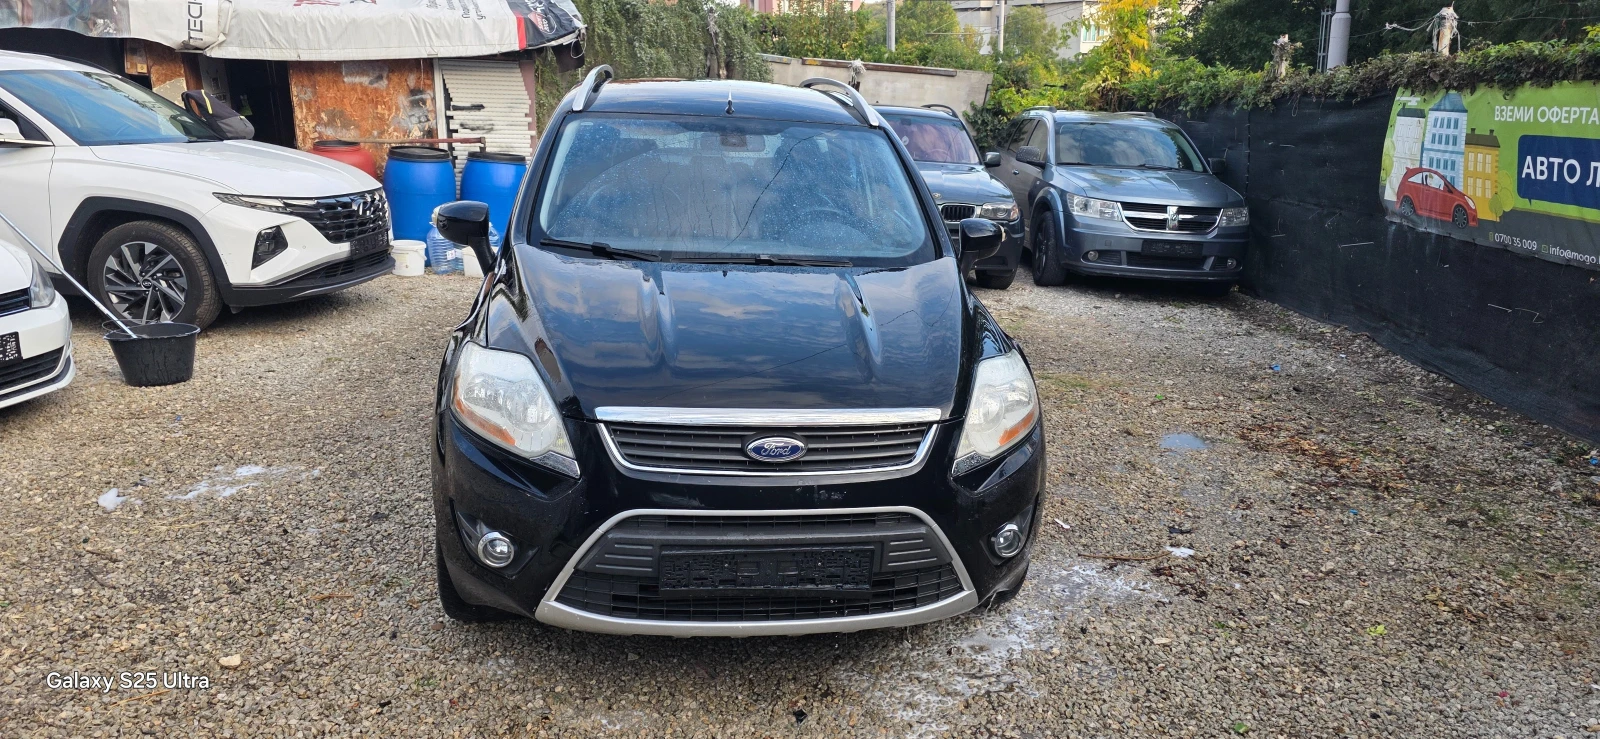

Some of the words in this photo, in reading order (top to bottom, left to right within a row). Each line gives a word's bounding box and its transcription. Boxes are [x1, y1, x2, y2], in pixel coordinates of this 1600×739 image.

[1494, 105, 1534, 123] ВЗЕМИ
[1537, 106, 1600, 125] ОФЕРТА
[1521, 155, 1581, 184] АВТО
[1494, 232, 1512, 245] 0700
[1512, 236, 1522, 247] 35
[1522, 239, 1538, 250] 009
[761, 442, 791, 456] Ford
